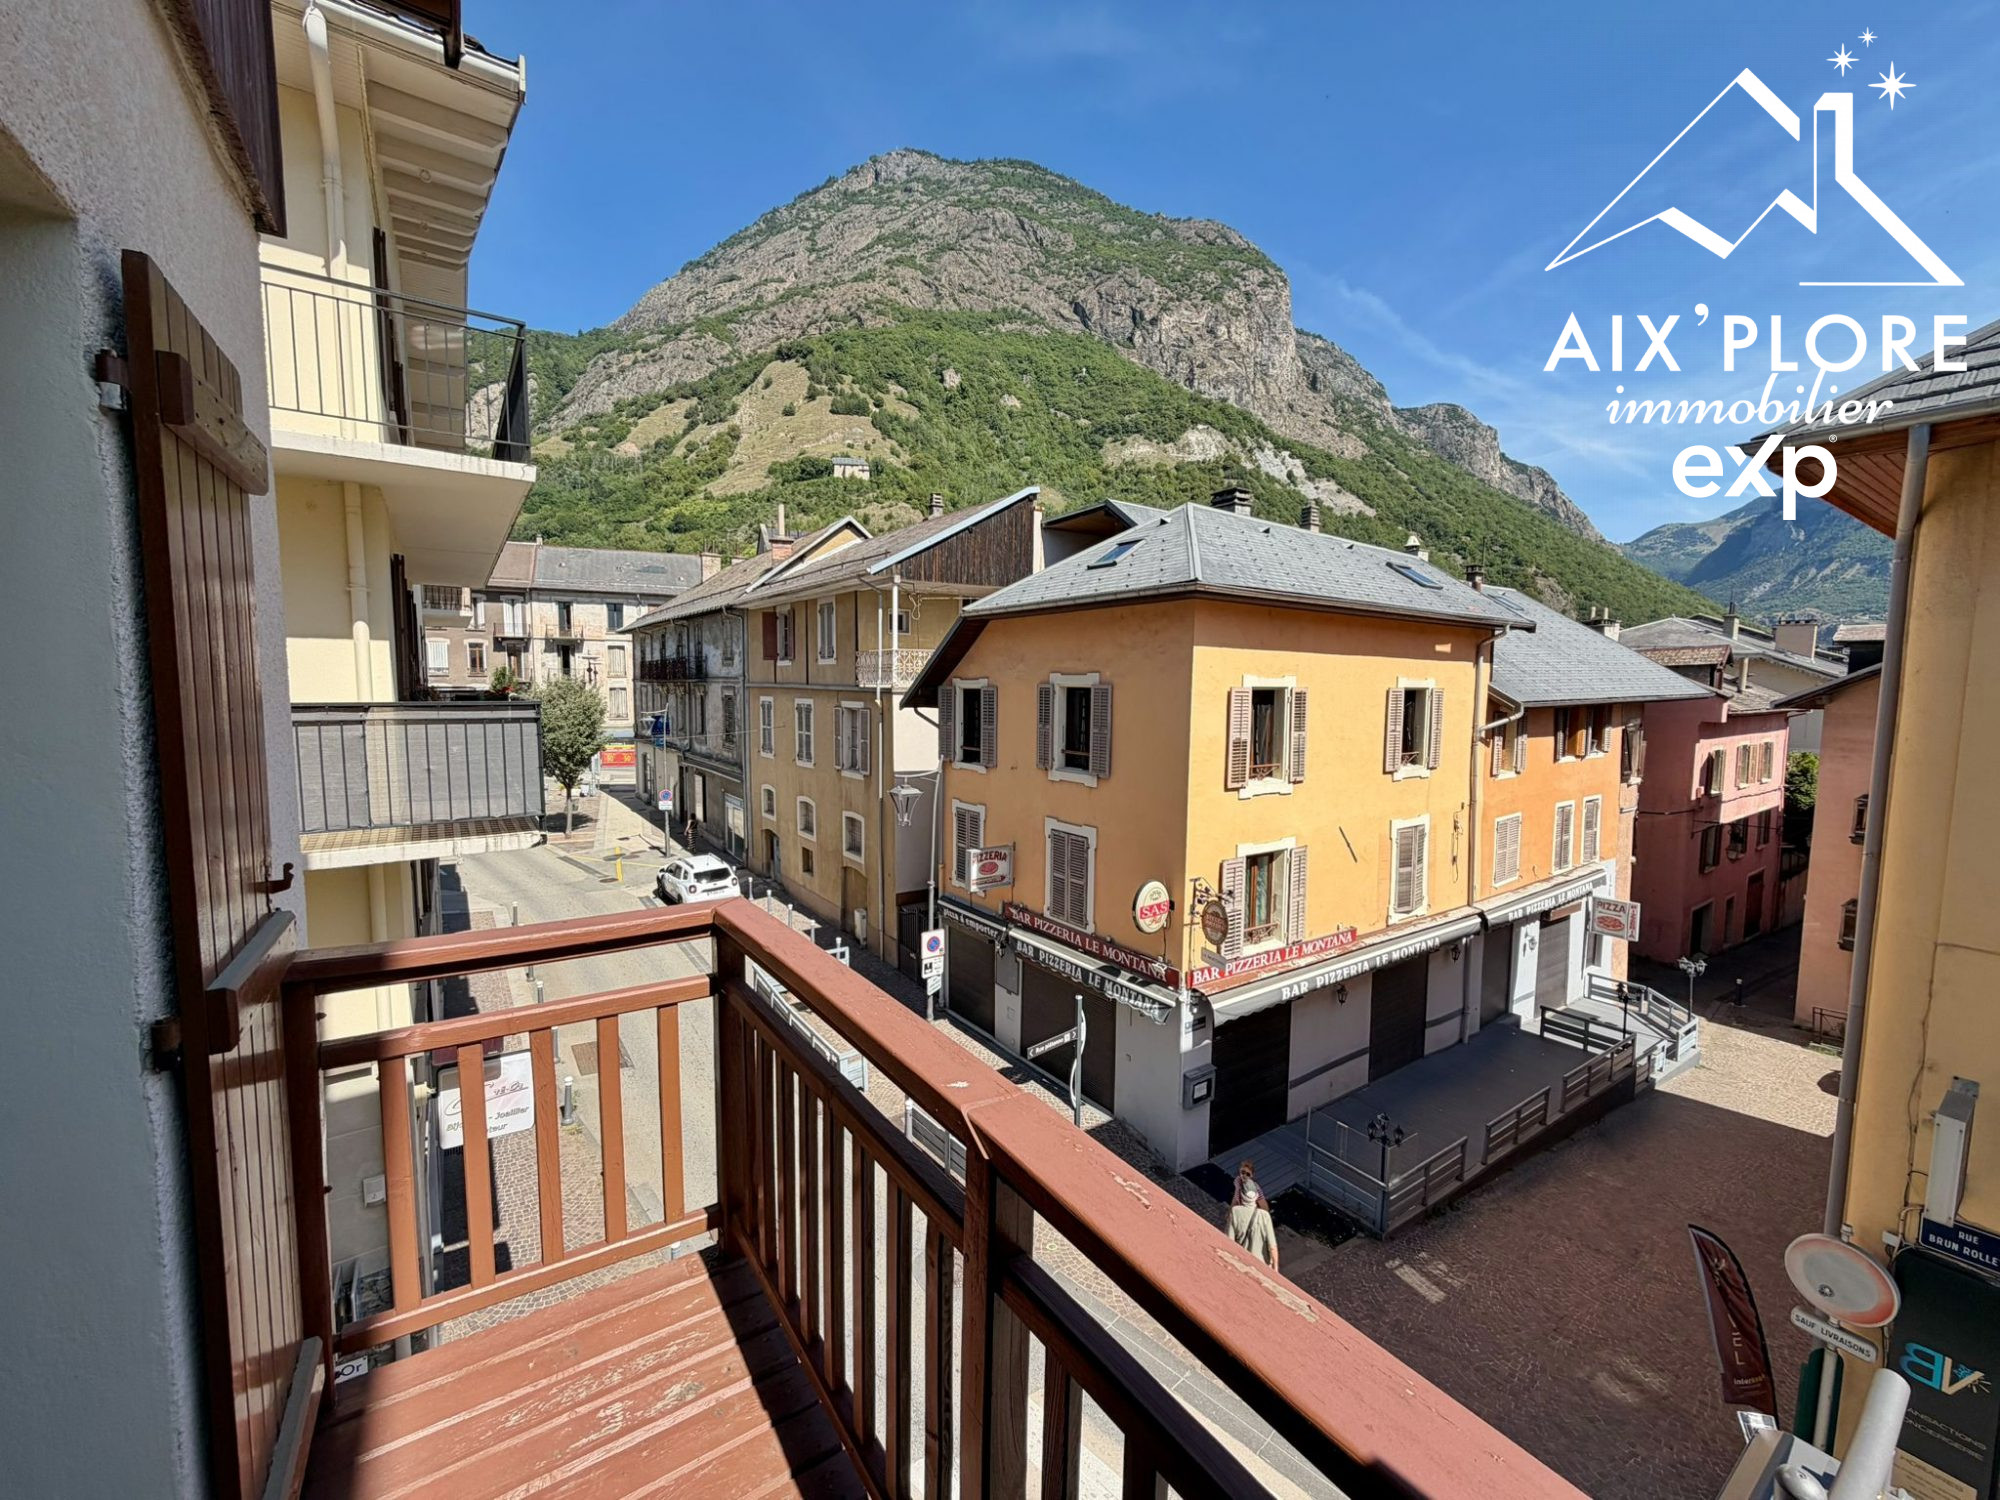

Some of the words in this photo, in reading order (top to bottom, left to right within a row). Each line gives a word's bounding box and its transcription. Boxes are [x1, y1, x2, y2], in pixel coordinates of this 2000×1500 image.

[943, 908, 959, 921] pizza
[965, 917, 999, 938] emporter
[1141, 901, 1169, 919] SAS
[1508, 909, 1523, 922] BAR
[1526, 897, 1556, 916] PIZZERIA
[1558, 892, 1566, 902] LE
[1566, 882, 1593, 899] MONTANA
[1597, 901, 1626, 914] PIZZA
[1011, 908, 1032, 926] BAR
[1034, 916, 1082, 947] PIZZERIA
[1085, 937, 1100, 954] LE
[1102, 946, 1167, 982] MONTANA
[1016, 941, 1034, 957] BAR
[1039, 950, 1083, 979] PIZZERIA
[1088, 976, 1101, 988] LE
[1193, 969, 1221, 985] BAR
[1225, 953, 1282, 975] PIZZERIA
[1285, 945, 1300, 961] LE
[1301, 931, 1353, 956] MONTANA
[1281, 980, 1309, 1001] BAR
[1316, 961, 1370, 989] PIZZERIA
[1392, 937, 1441, 961] MONTANA
[1928, 1233, 1960, 1252] BRUN
[1963, 1246, 2000, 1267] ROLLE
[1958, 1230, 1980, 1245] RUE
[1794, 1313, 1817, 1331] SAUF
[1820, 1327, 1872, 1358] LIVRAISONS
[1903, 1416, 1984, 1461] ONCIERGERIE
[1907, 1406, 1987, 1450] ANSACTIONS
